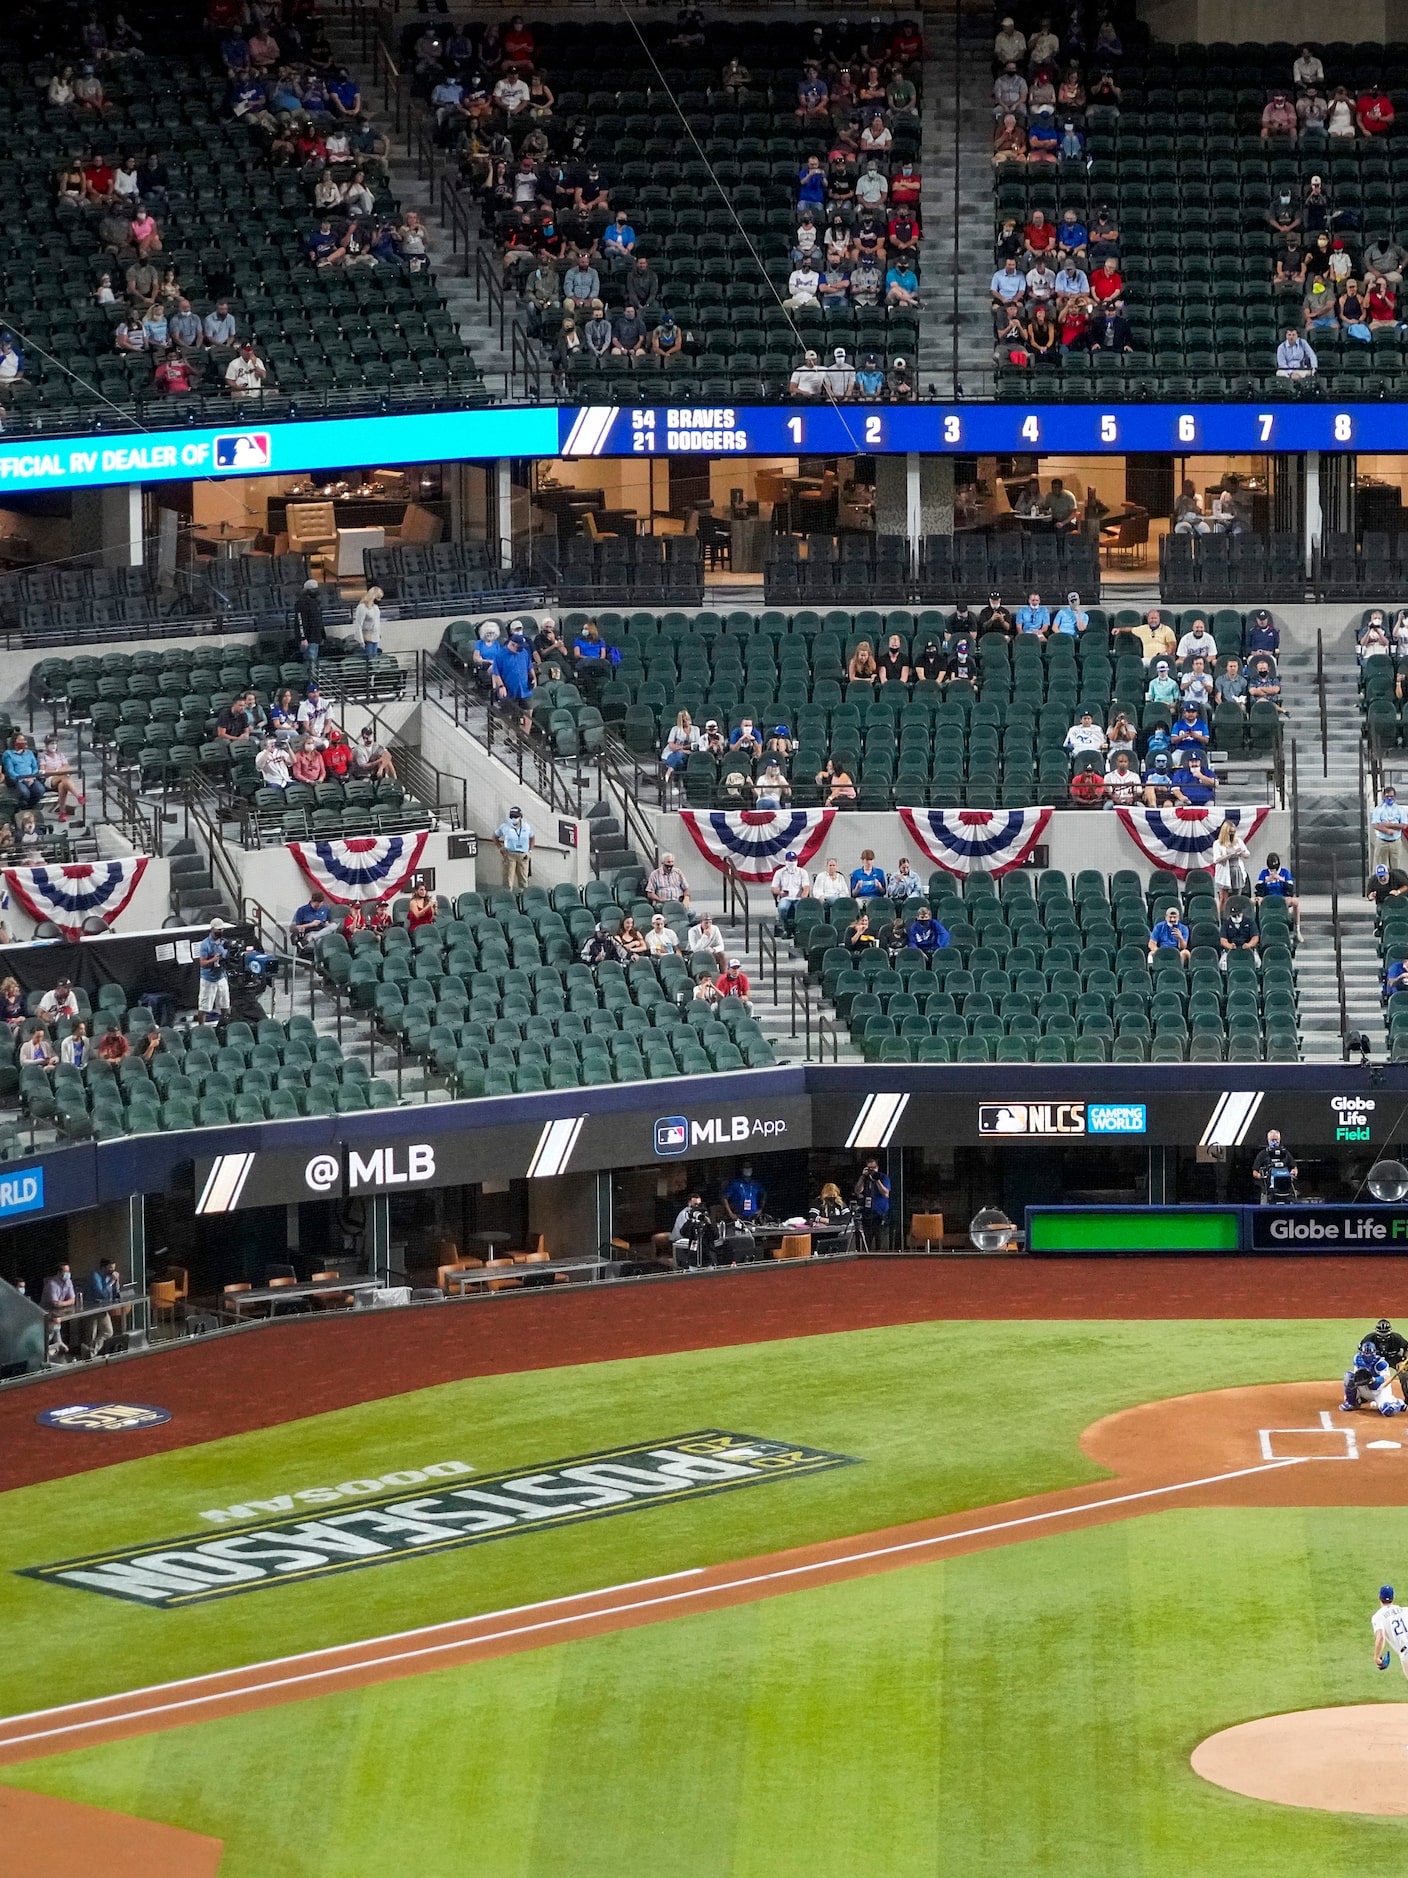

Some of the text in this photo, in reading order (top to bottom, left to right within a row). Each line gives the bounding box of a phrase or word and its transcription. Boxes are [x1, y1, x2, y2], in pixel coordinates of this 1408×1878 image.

[632, 409, 735, 429] 54 BRAVES
[787, 416, 803, 444] 1
[865, 416, 882, 443] 2
[944, 415, 961, 443] 3
[1022, 415, 1040, 442] 4
[1101, 415, 1117, 442] 5
[1179, 414, 1195, 441] 6
[1258, 414, 1274, 441] 7
[1335, 414, 1352, 441] 8
[632, 431, 747, 451] 21 DODGERS
[70, 452, 98, 474] RV
[101, 446, 177, 472] DEALER
[181, 443, 210, 464] OF
[468, 845, 477, 855] 15
[1090, 1108, 1143, 1119] CAMPING
[1330, 1096, 1376, 1111] Globe
[691, 1116, 750, 1146] MLB
[1029, 1105, 1085, 1133] NLCS
[1092, 1118, 1143, 1131] WORLD
[1338, 1111, 1368, 1126] Life
[1336, 1127, 1370, 1141] Field
[1270, 1218, 1339, 1239] Globe
[1344, 1218, 1387, 1239] Life
[199, 1460, 476, 1523] DOOSAN
[65, 1449, 763, 1599] POSTSEASON
[1391, 1617, 1408, 1636] 21
